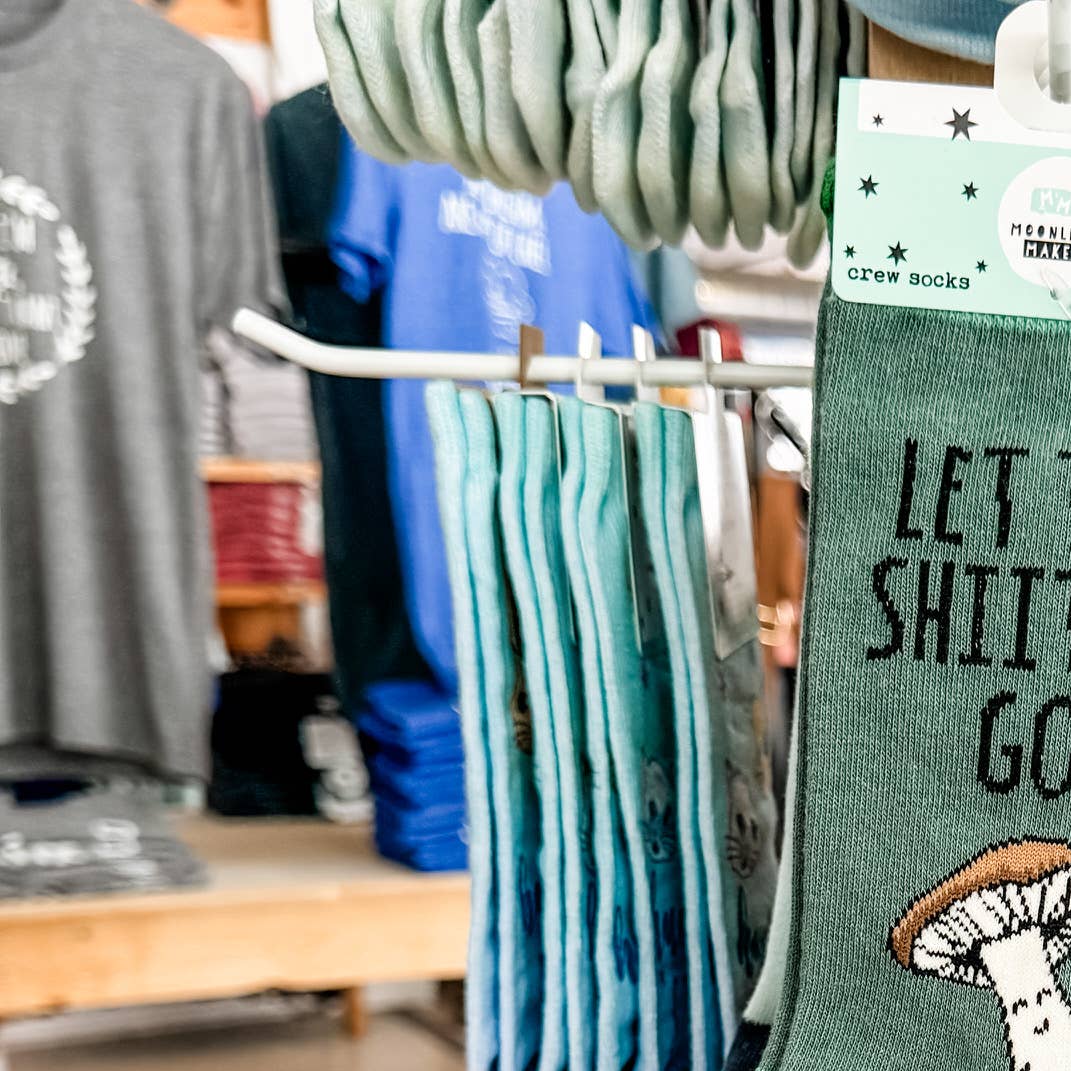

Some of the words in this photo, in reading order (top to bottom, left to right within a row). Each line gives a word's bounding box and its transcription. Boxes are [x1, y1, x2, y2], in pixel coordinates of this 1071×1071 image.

[847, 265, 900, 285] crew
[908, 271, 971, 291] socks
[894, 437, 1030, 551] LET
